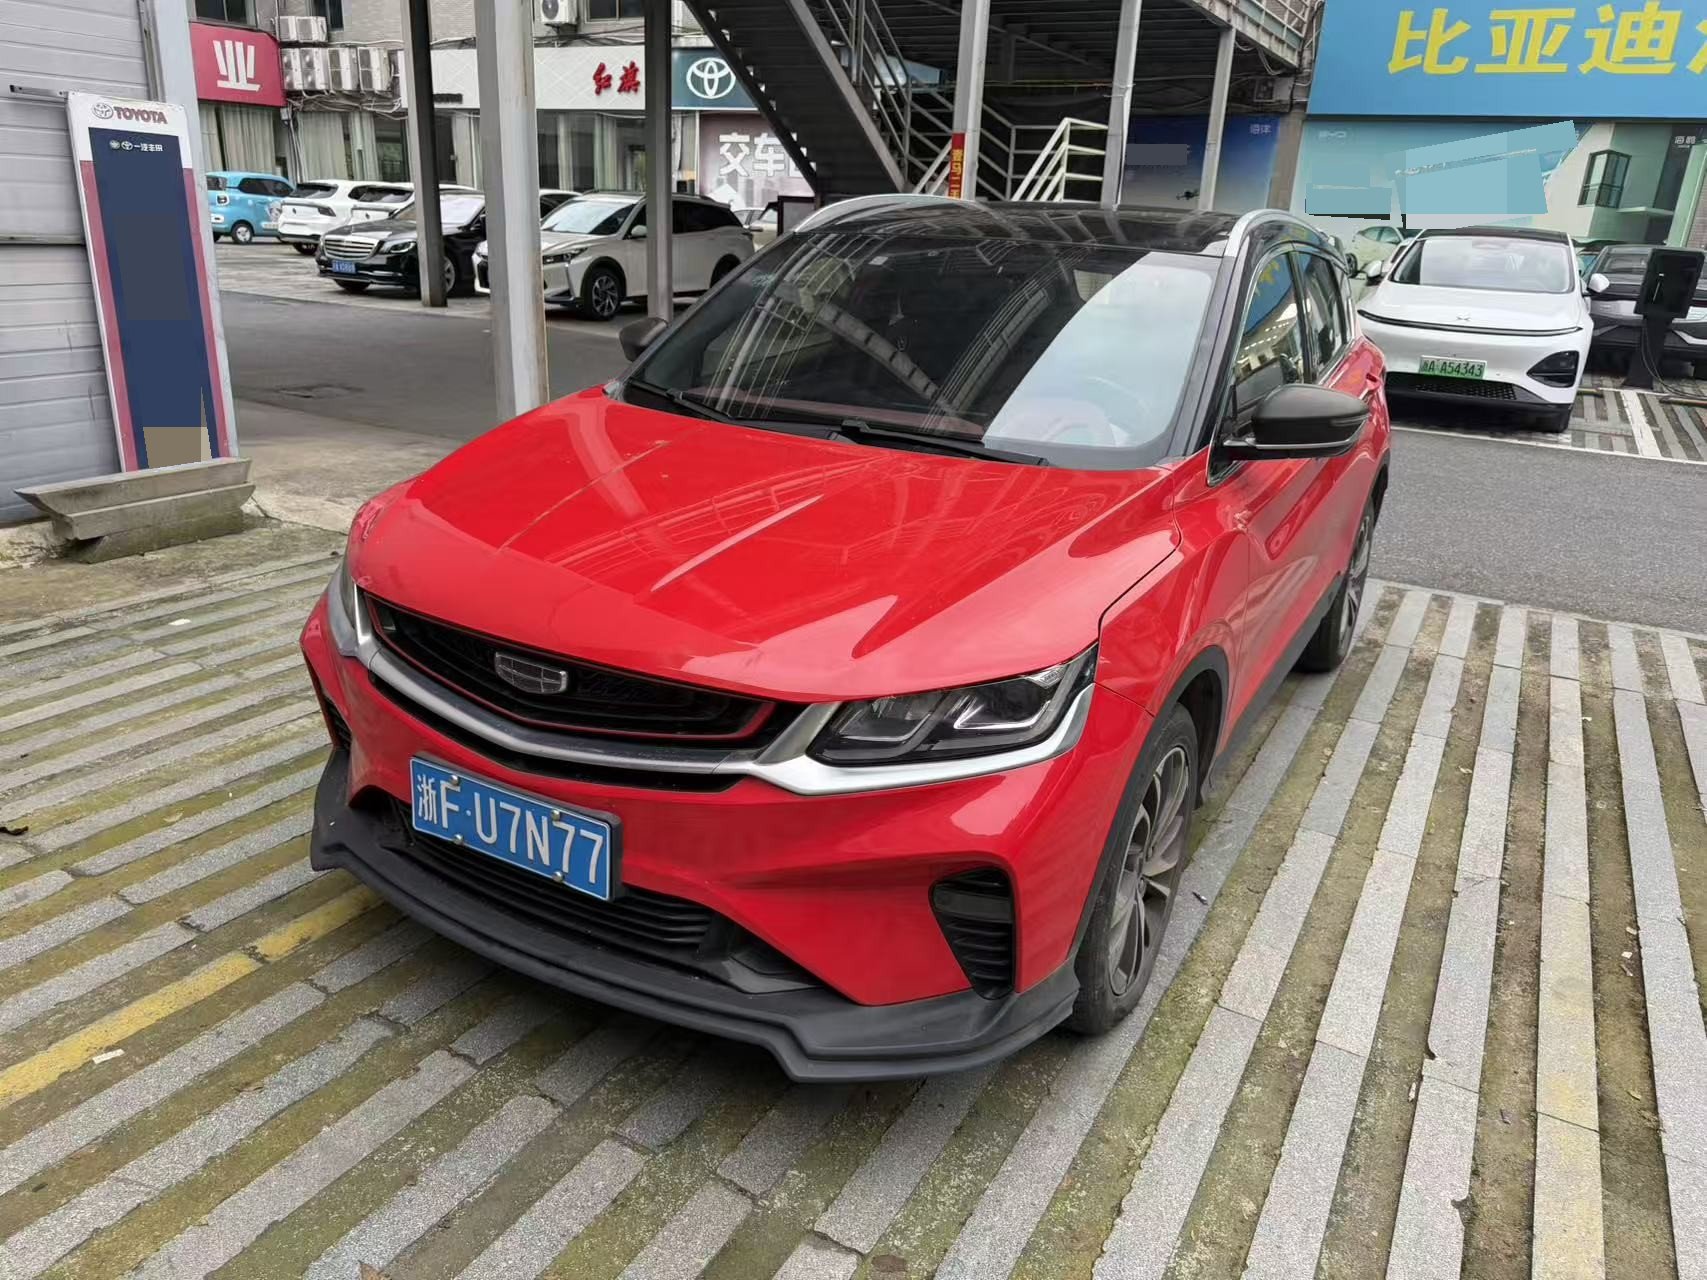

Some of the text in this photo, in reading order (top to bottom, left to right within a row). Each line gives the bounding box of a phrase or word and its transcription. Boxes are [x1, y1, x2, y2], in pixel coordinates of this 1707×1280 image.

[1388, 0, 1707, 74] 比亚迪
[213, 40, 260, 91] 业
[593, 61, 640, 95] 红旗
[113, 106, 167, 124] TOYOTA
[417, 773, 604, 884] 浙F·U7N77
